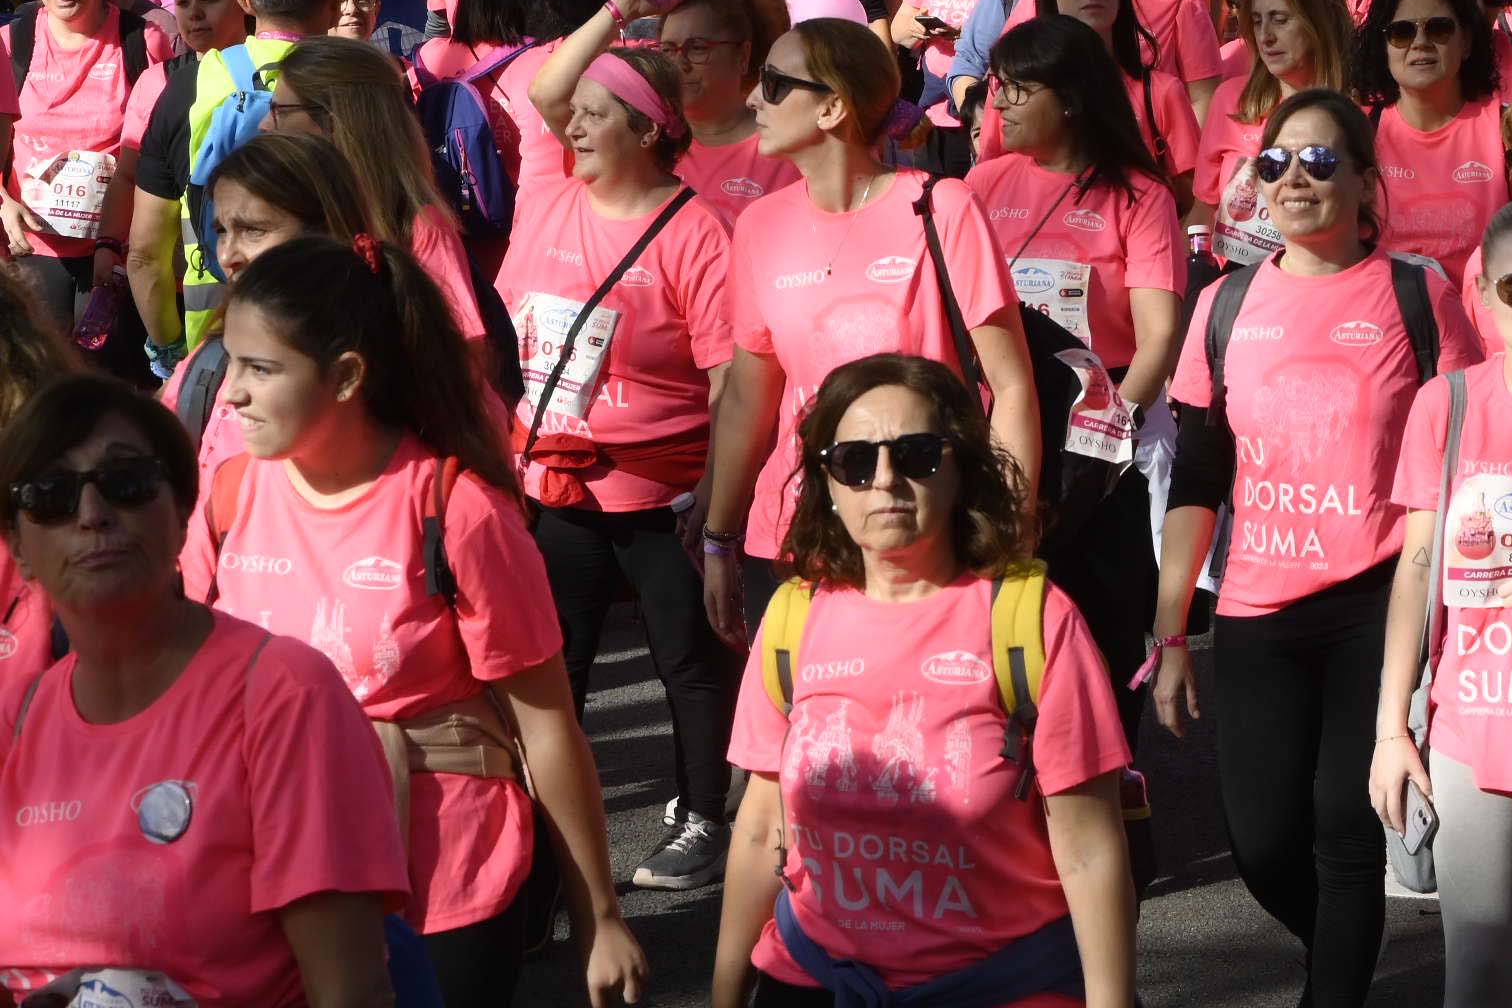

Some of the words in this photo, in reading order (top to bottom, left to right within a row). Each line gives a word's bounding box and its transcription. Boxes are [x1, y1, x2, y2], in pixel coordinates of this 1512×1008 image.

[53, 183, 87, 198] 016
[1255, 224, 1282, 242] 30258
[1217, 241, 1249, 257] OYSHO
[775, 269, 826, 290] OYSHO
[1014, 278, 1053, 288] STURIANA
[1078, 434, 1117, 454] OYSHO
[1243, 476, 1362, 516] DORSAL
[1242, 520, 1326, 558] SUMA
[222, 552, 292, 575] OYSHO
[1463, 569, 1506, 579] CARRERA
[802, 657, 865, 683] OYSHO
[833, 831, 977, 871] DORSAL
